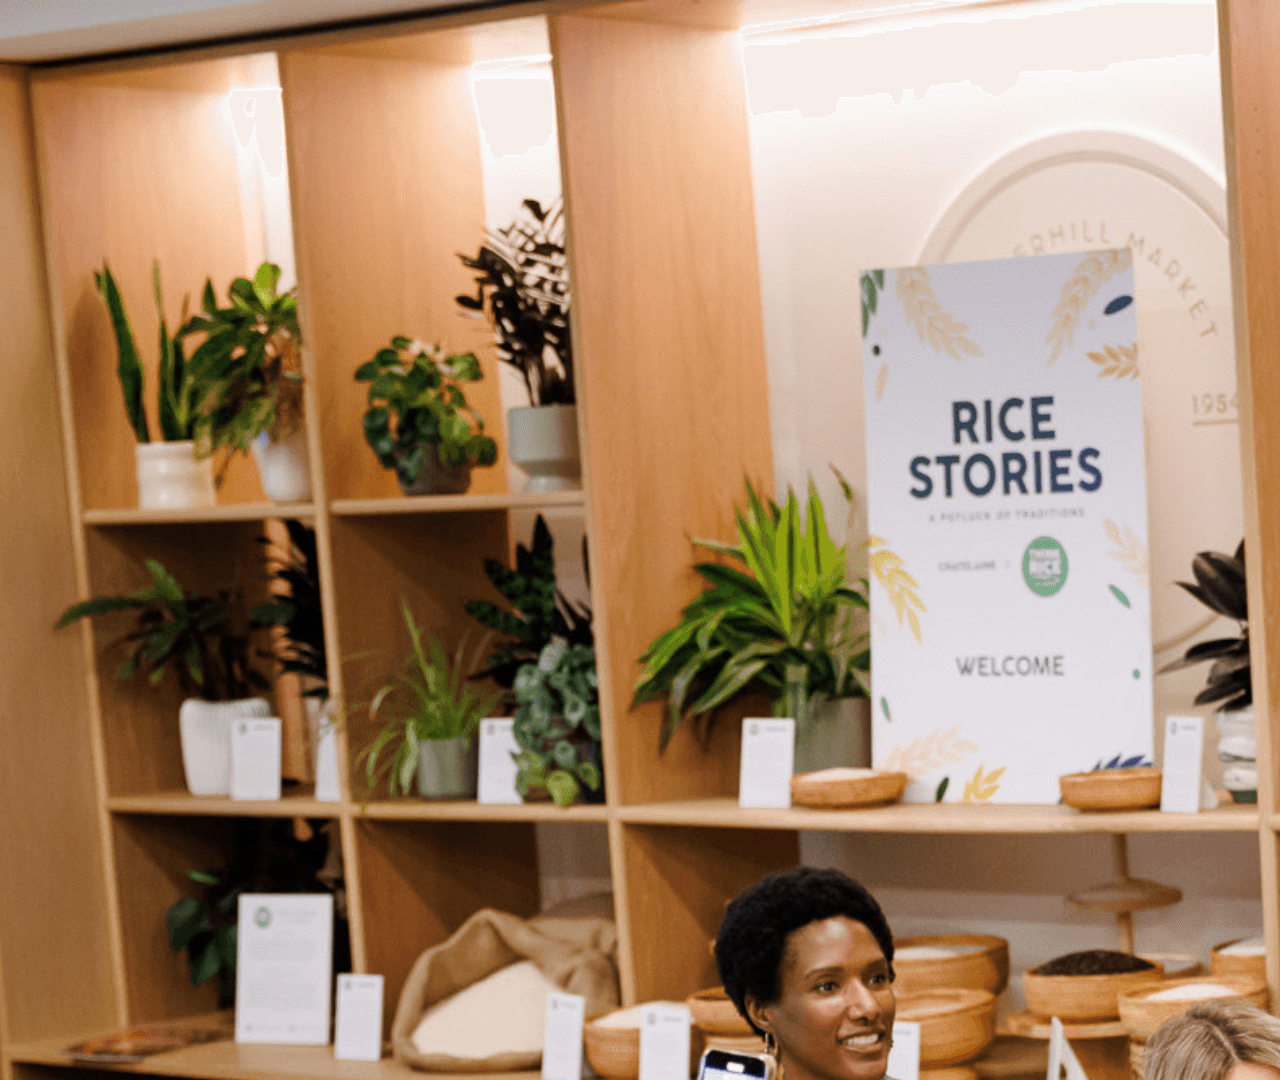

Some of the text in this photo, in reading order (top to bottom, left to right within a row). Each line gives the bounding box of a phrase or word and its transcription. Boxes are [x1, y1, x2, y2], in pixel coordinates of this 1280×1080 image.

[1125, 232, 1218, 338] MARKET
[952, 395, 1056, 444] RICE
[909, 447, 1102, 499] STORIES
[940, 511, 990, 522] POTLUCK
[996, 510, 1011, 520] OF
[1015, 507, 1085, 519] TRADITIONS
[956, 655, 1065, 676] WELCOME
